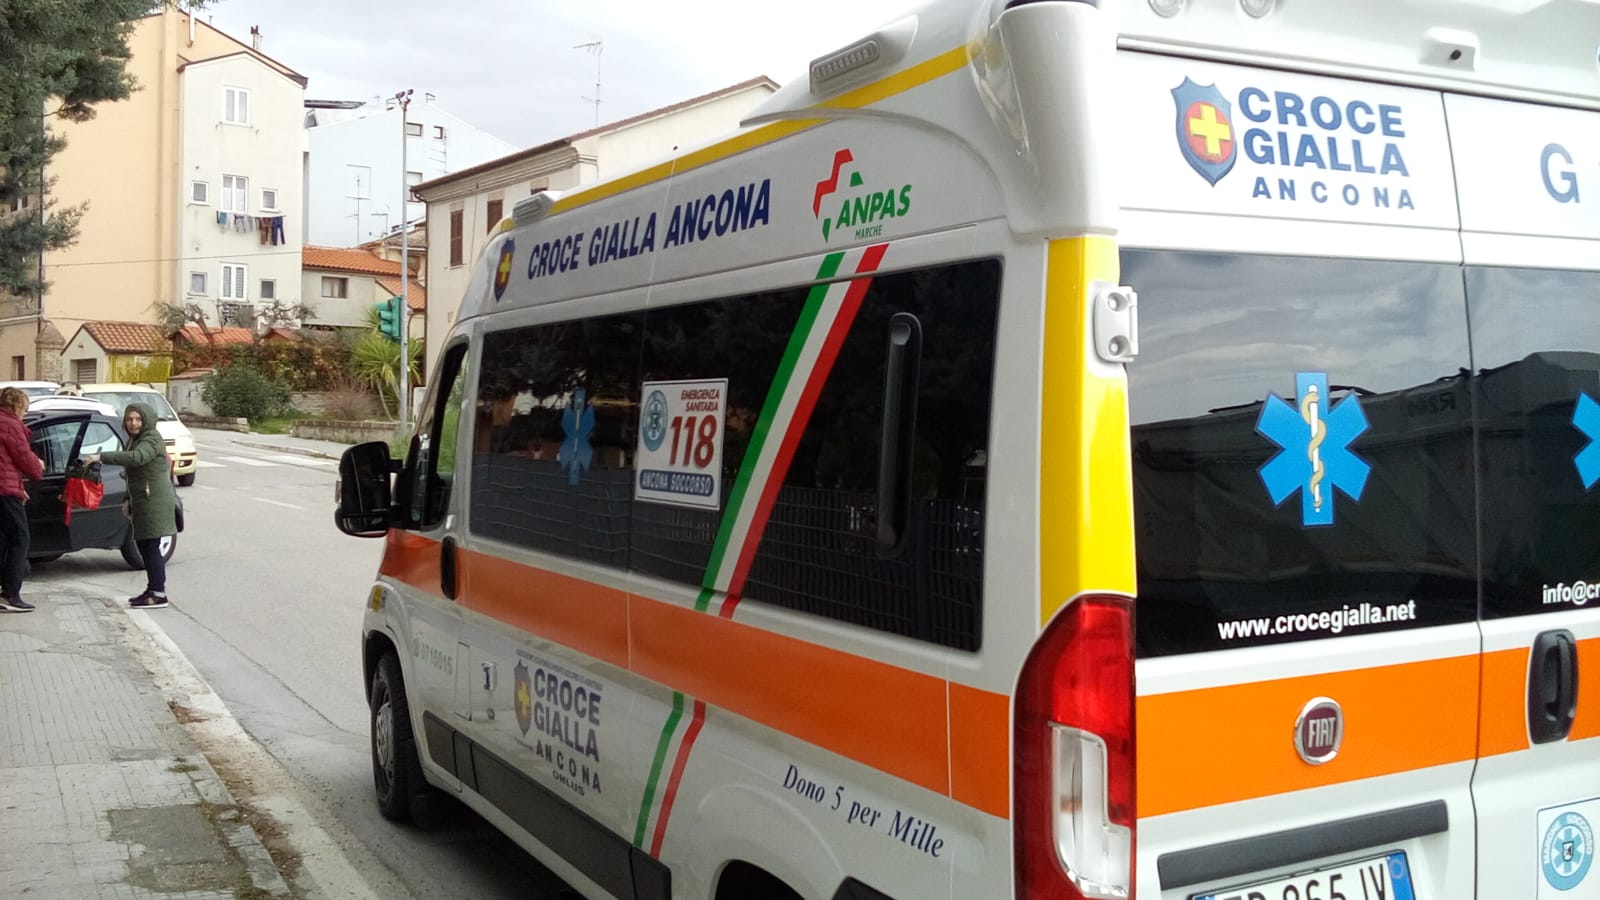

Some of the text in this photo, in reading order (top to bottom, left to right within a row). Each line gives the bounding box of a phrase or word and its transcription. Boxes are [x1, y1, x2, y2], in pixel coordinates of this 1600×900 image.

[1238, 86, 1406, 138] CROCE
[1243, 128, 1410, 177] GIALLA
[835, 184, 912, 229] ANPAS
[1252, 176, 1415, 210] ANCONA
[527, 178, 771, 280] CROCE GIALLA ANCONA
[854, 225, 883, 240] MARCHE
[681, 389, 720, 400] EMERGENZA
[685, 401, 719, 412] SANITARIA
[669, 414, 718, 469] 118
[641, 470, 712, 494] ANCONA SOCCORSO
[1218, 599, 1417, 640] www.crocegialla.net
[534, 668, 602, 726] CROCE
[533, 701, 600, 762] GIALLA
[1308, 716, 1337, 748] FIAT
[536, 739, 602, 793] ANCONA
[552, 769, 585, 796] ONLUS
[783, 764, 944, 858] Dono 5 per Mille
